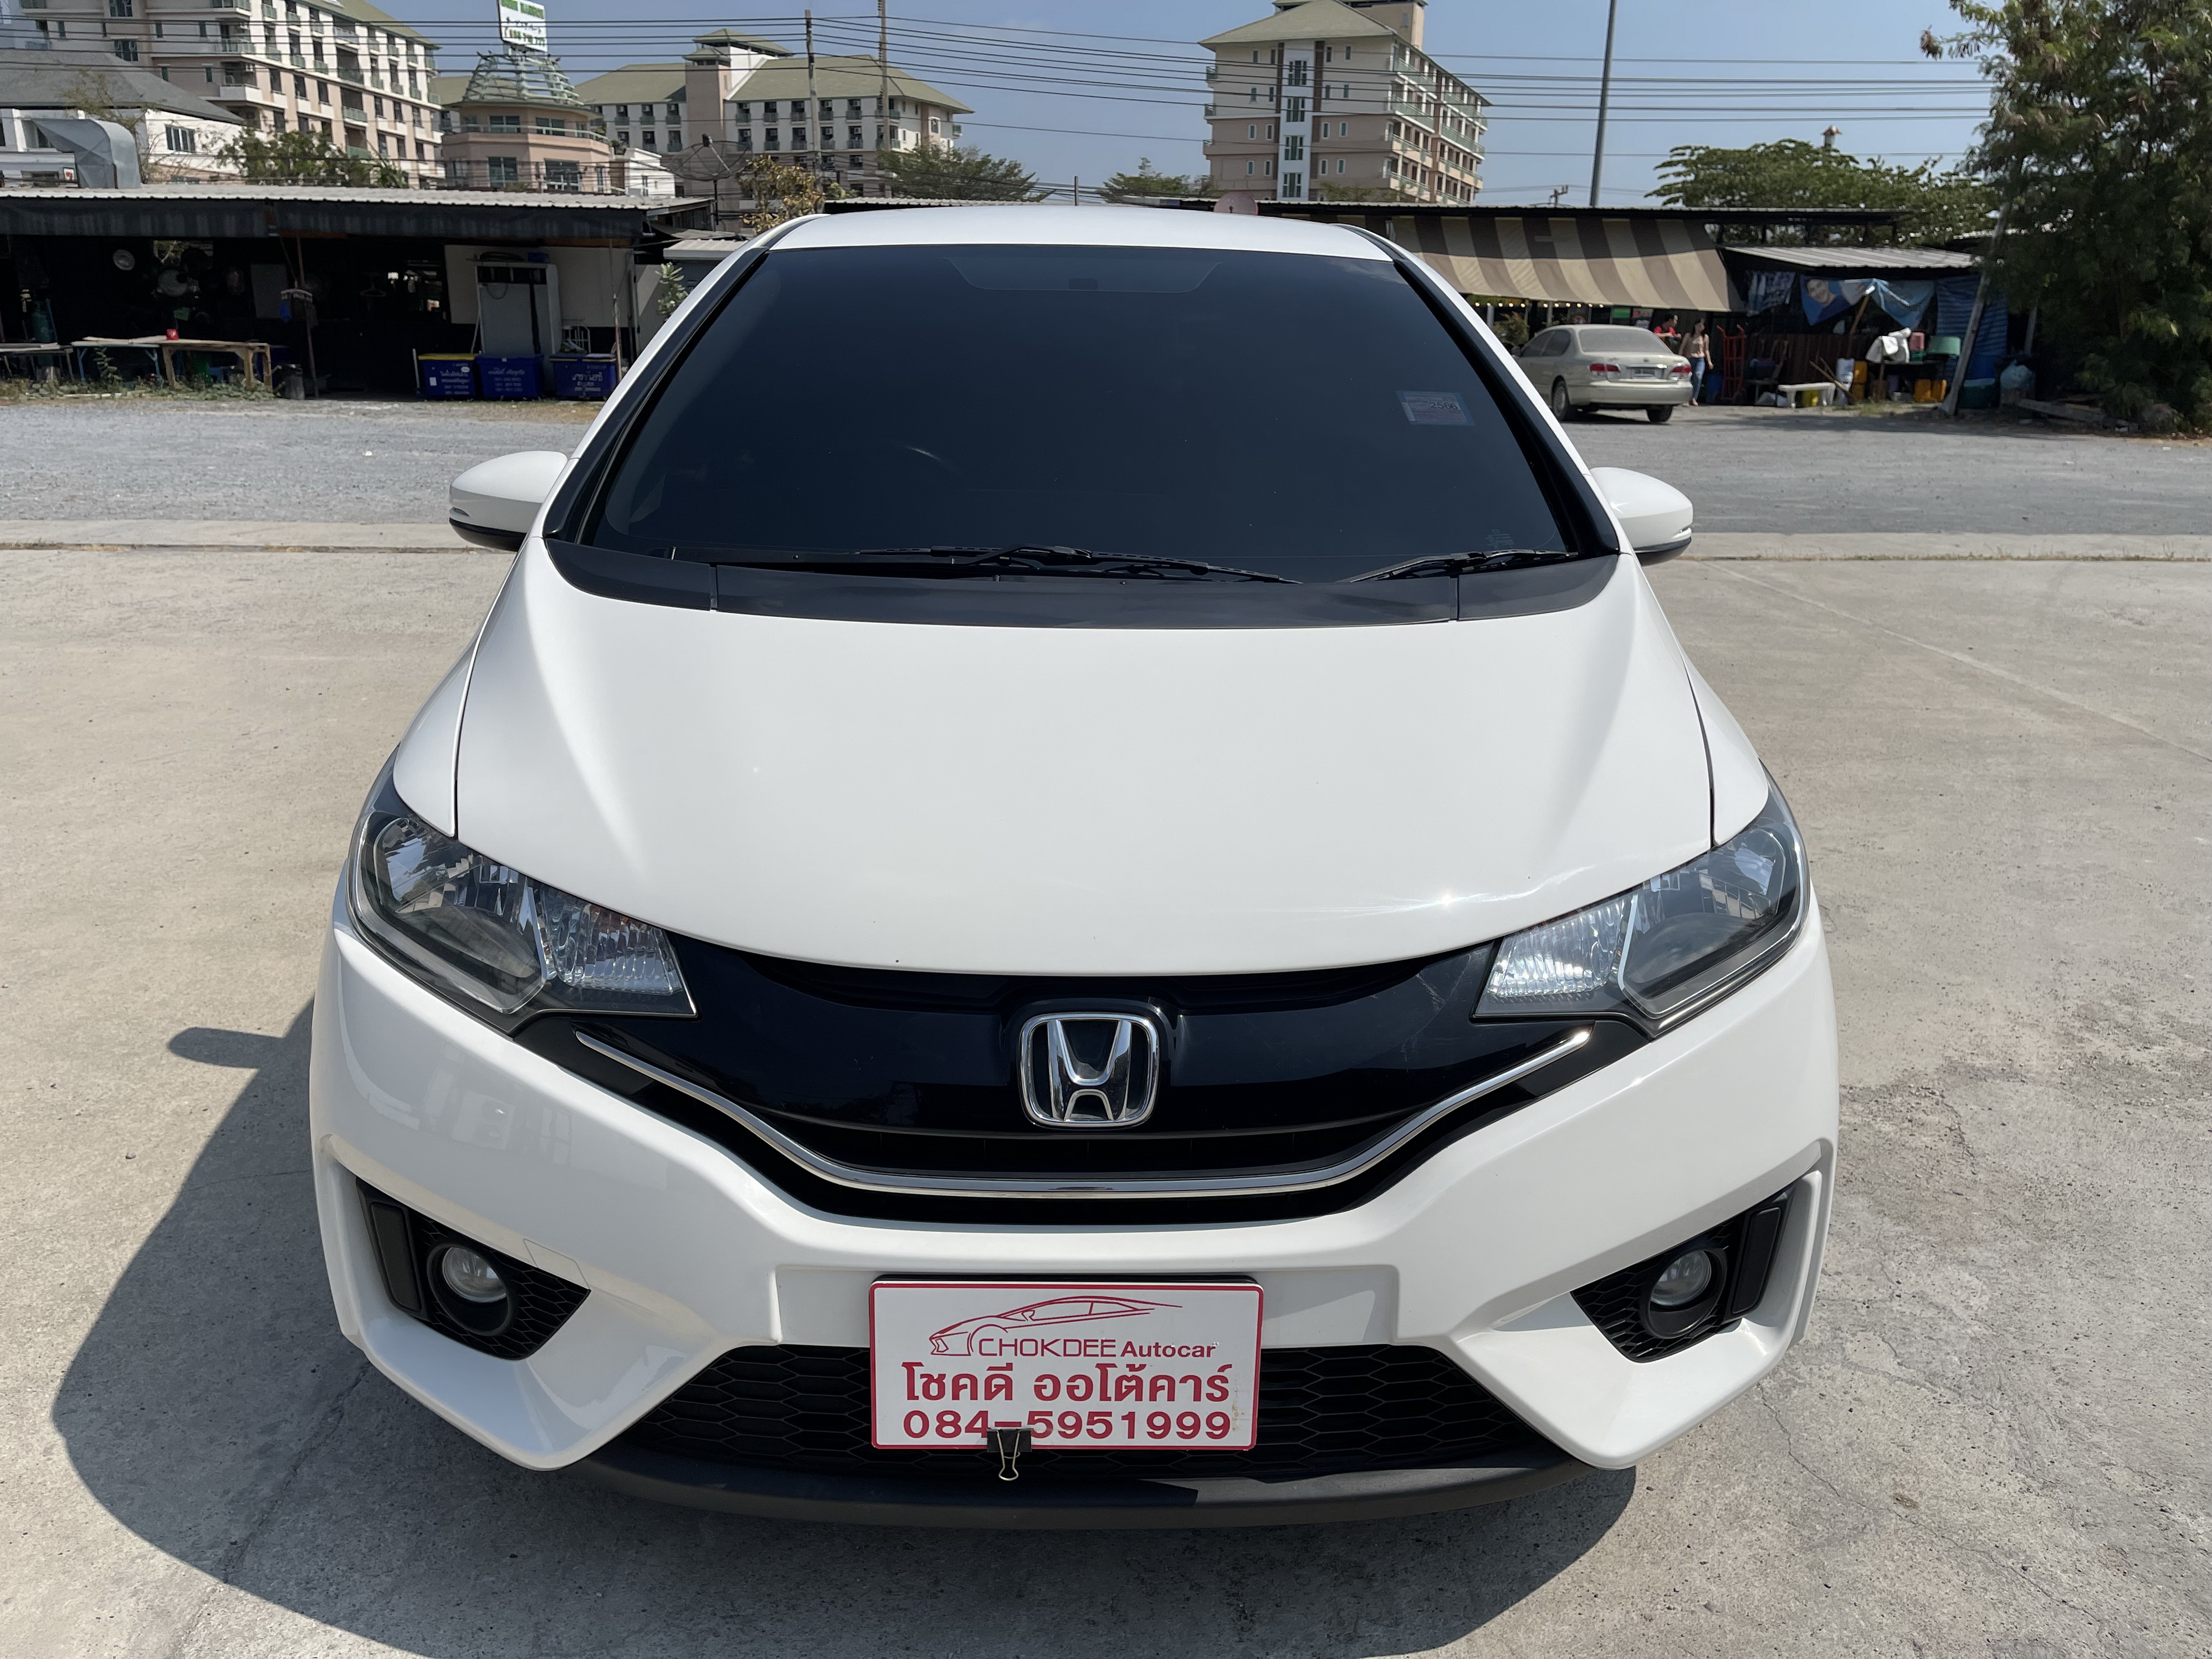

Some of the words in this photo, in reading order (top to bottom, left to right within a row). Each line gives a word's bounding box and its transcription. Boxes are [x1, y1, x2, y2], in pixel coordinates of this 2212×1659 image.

[1428, 401, 1458, 411] 2566
[979, 1338, 1117, 1357] CHOKDEE
[1120, 1341, 1216, 1358] Autocar
[901, 1361, 1013, 1401] โชคดี
[1033, 1363, 1233, 1402] ออโต้คาร์
[903, 1410, 1231, 1440] 084-5951999
